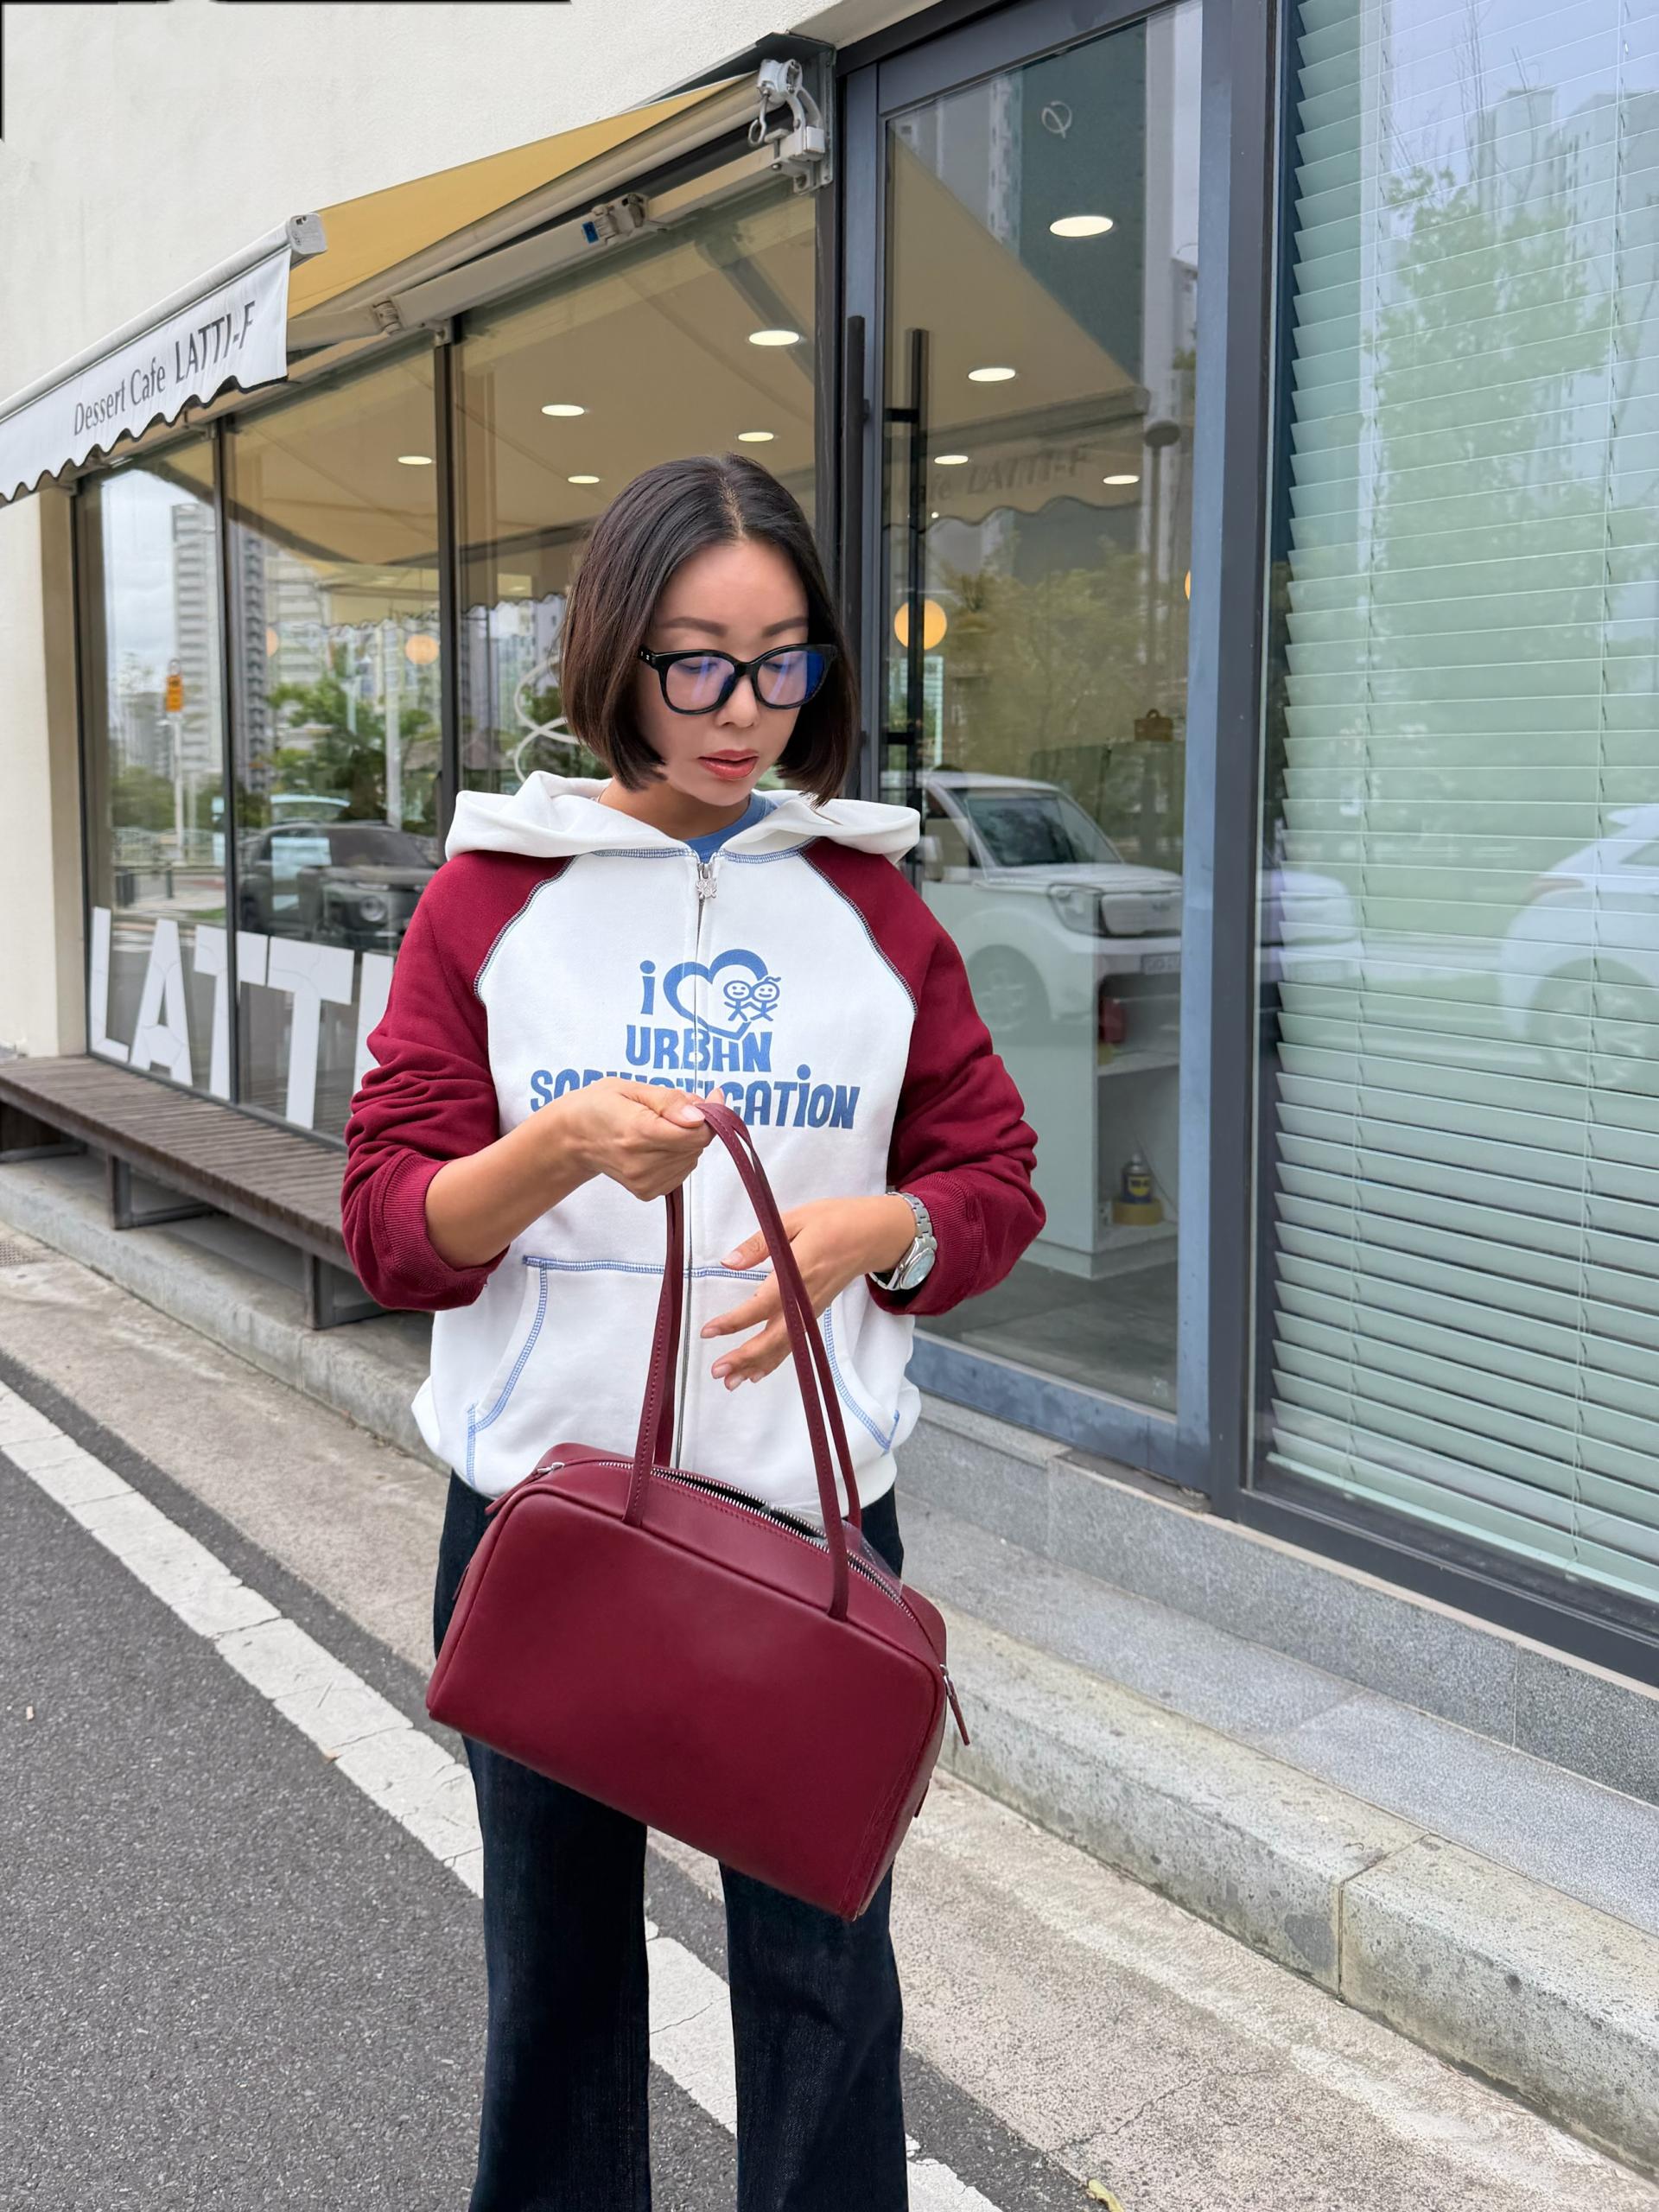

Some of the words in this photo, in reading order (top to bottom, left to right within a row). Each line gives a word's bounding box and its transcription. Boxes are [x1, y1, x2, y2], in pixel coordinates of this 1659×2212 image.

[74, 378, 125, 435] Dessert
[130, 357, 166, 406] Cafe
[175, 300, 256, 384] LATTI-F
